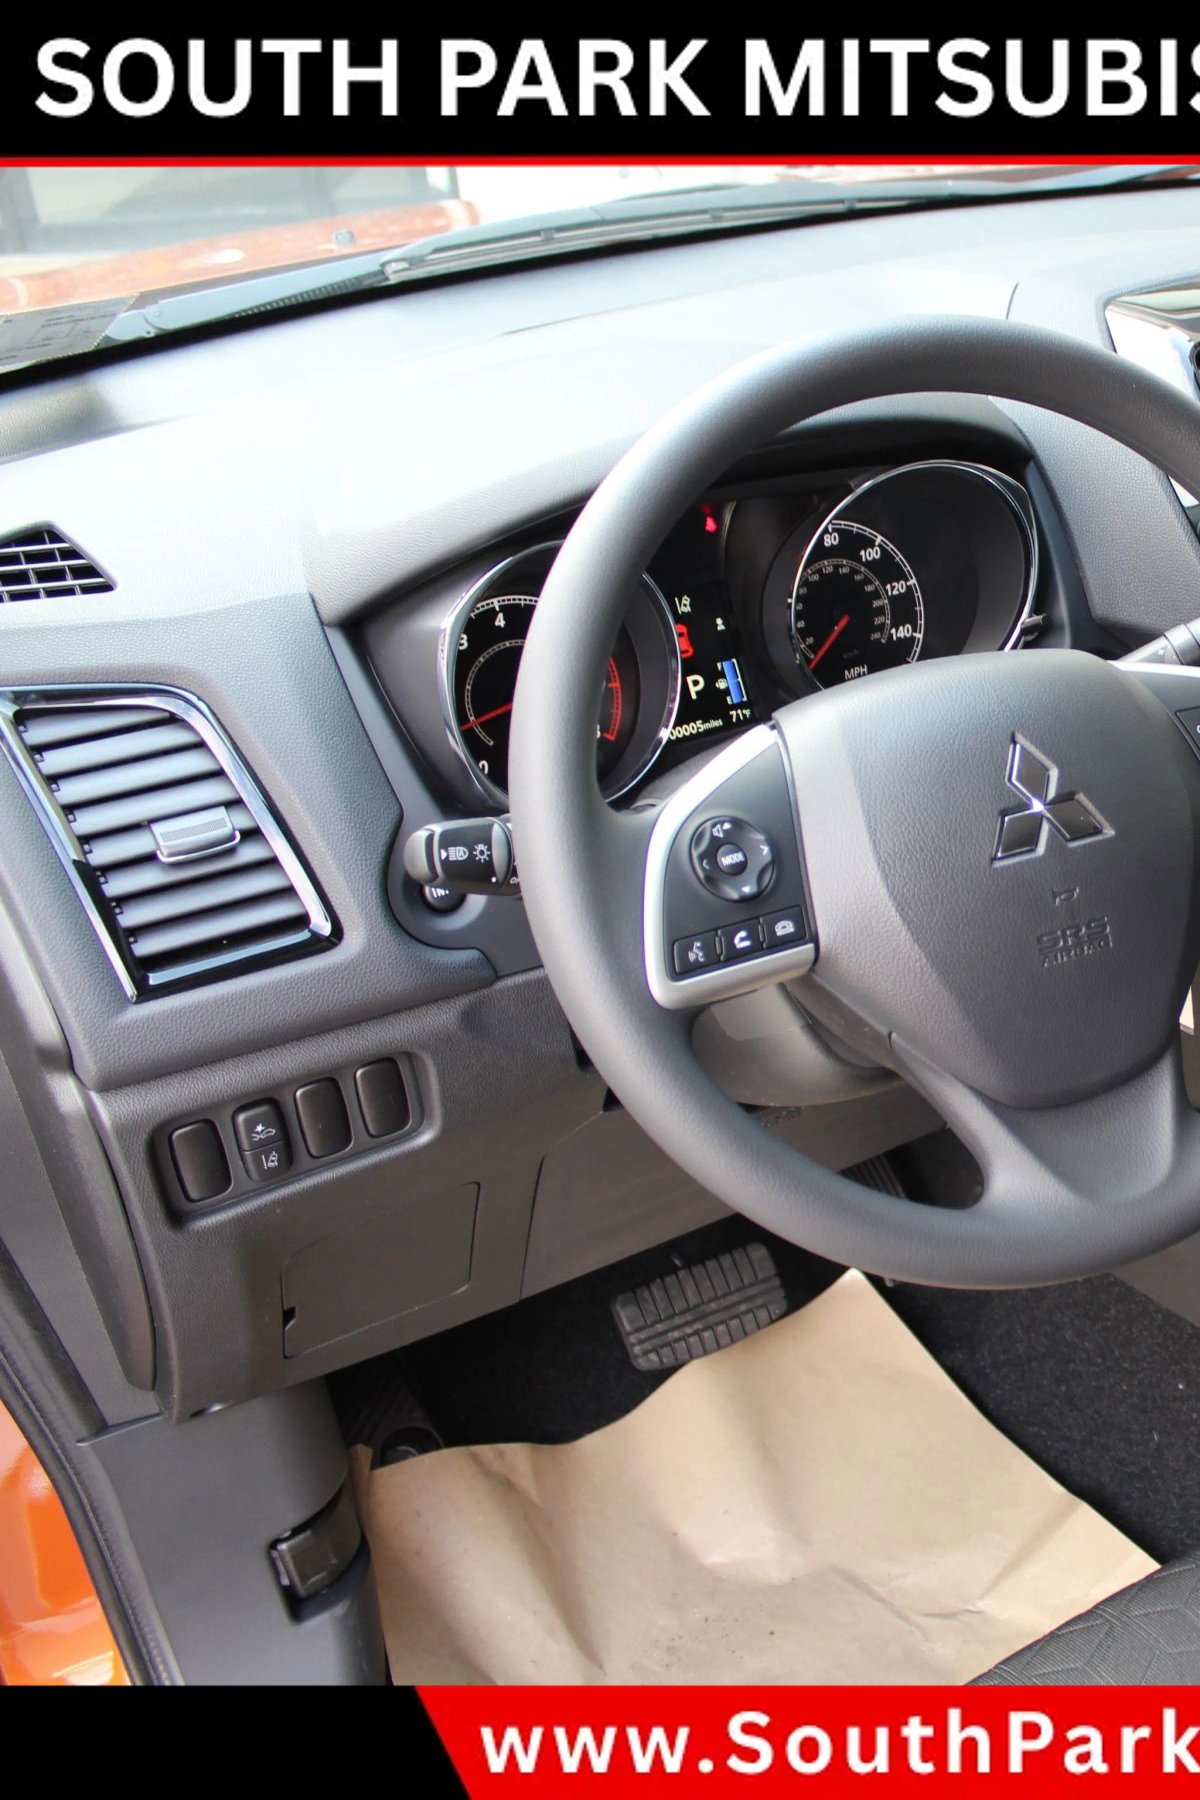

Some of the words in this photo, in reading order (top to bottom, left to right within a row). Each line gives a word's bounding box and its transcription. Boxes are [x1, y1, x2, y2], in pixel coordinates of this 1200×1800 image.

[823, 532, 839, 547] 80
[859, 547, 881, 562] 100
[886, 580, 907, 597] 120
[494, 612, 506, 629] 4
[890, 624, 912, 641] 140
[844, 664, 868, 681] MPH
[686, 674, 705, 700] P
[721, 851, 745, 867] MODE
[1036, 916, 1111, 951] SRS
